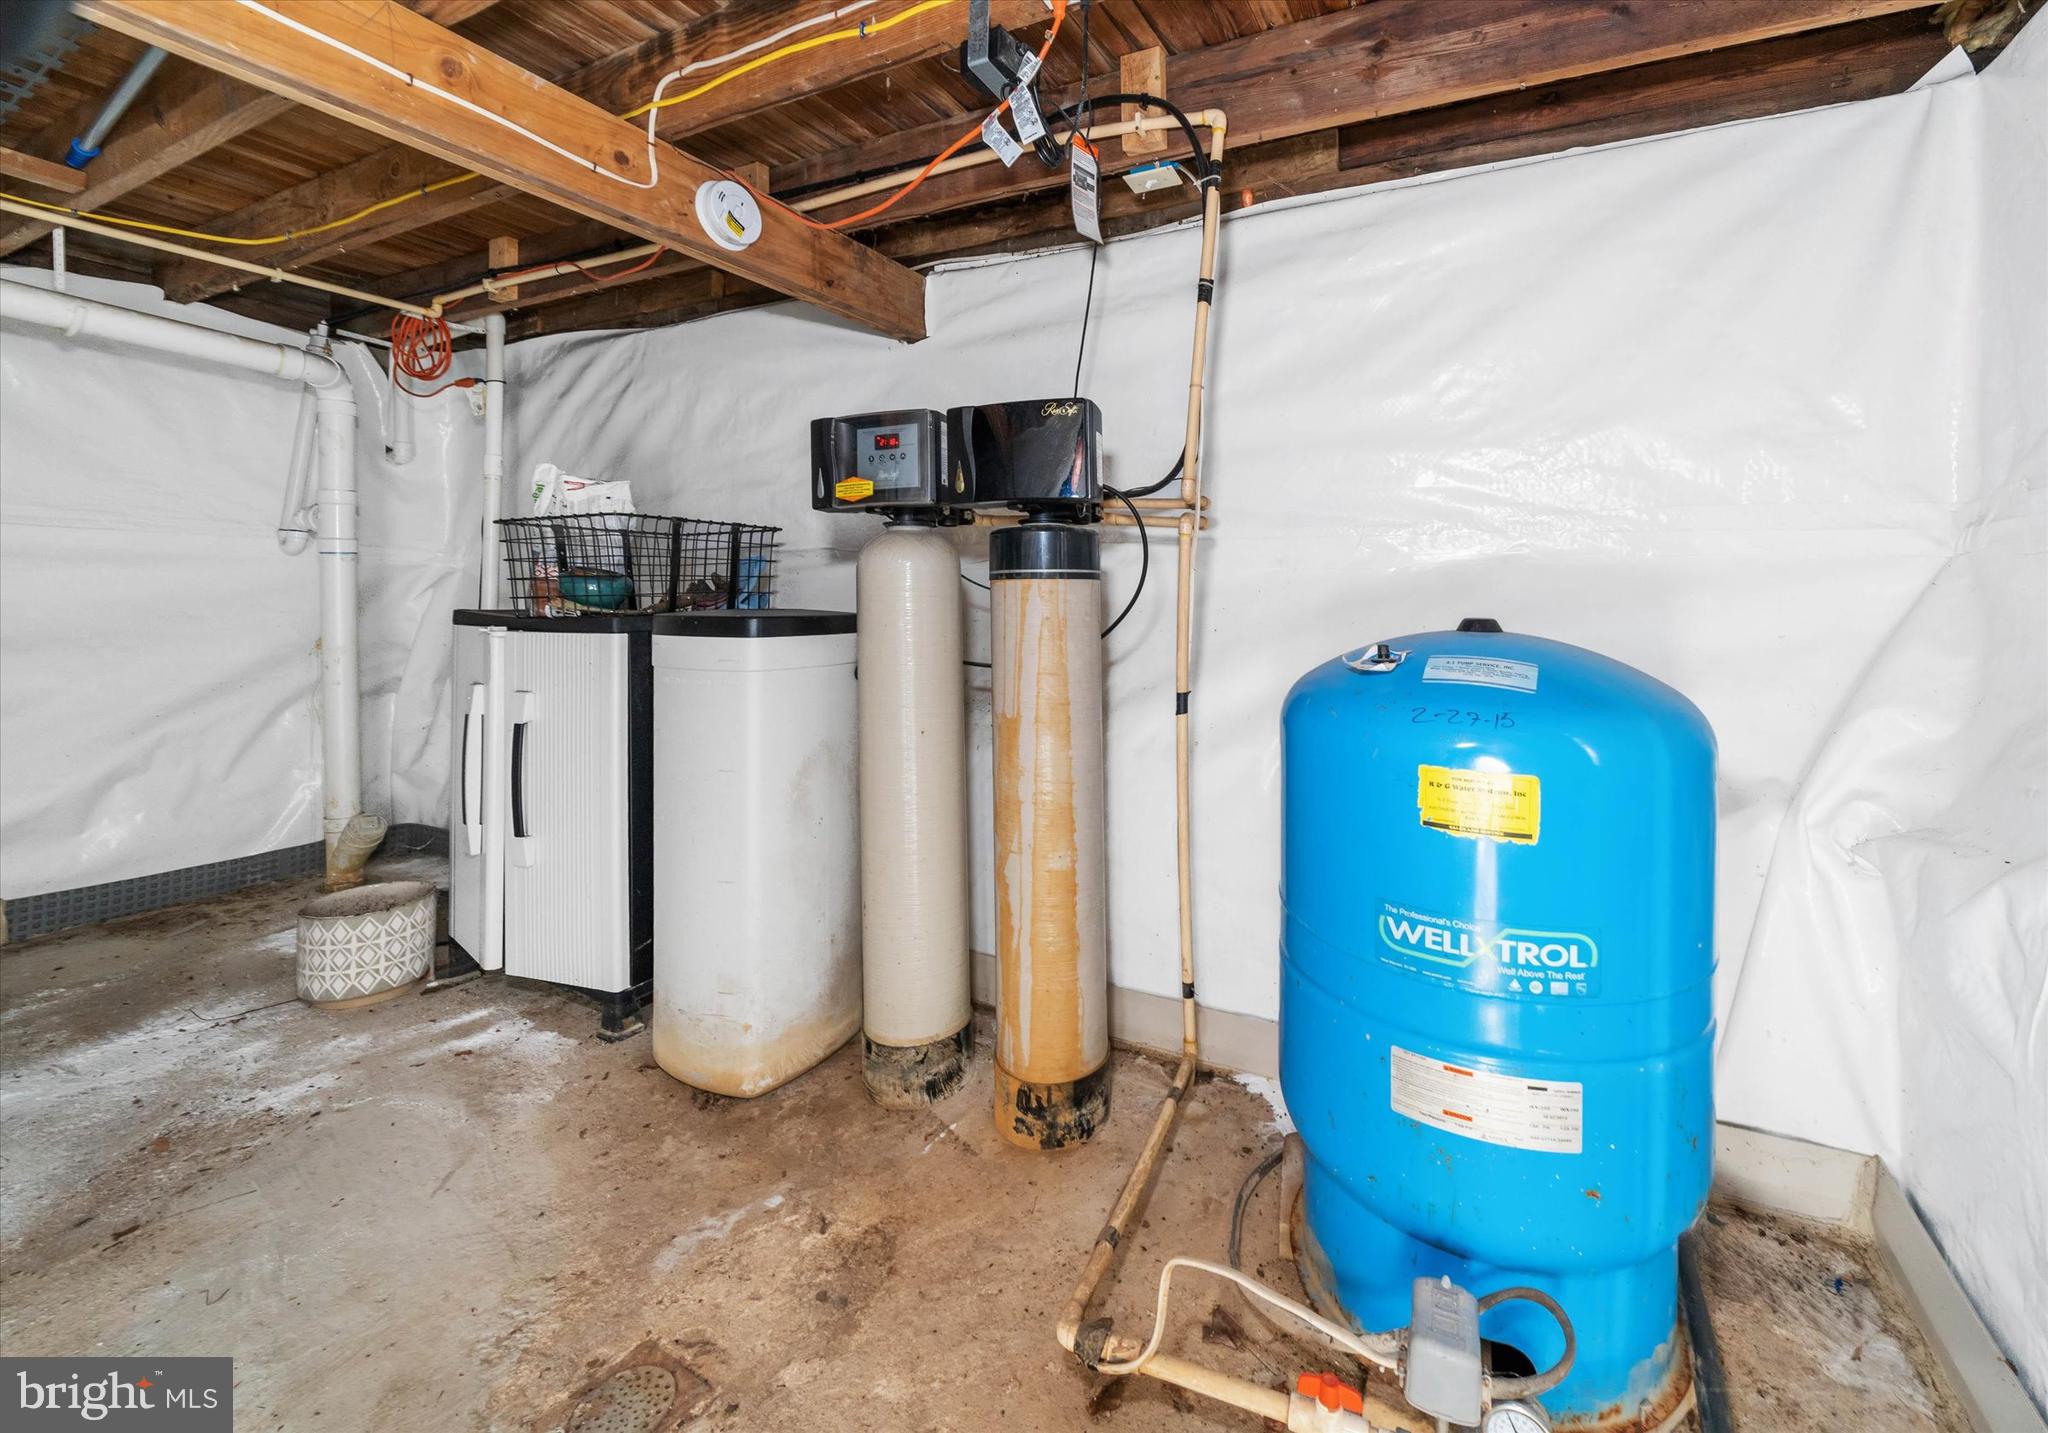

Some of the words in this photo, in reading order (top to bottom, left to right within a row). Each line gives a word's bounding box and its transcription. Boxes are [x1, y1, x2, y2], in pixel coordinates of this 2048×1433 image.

[531, 483, 546, 503] eal
[1384, 904, 1398, 915] The
[1399, 907, 1452, 927] Professional's
[1497, 966, 1517, 977] Well
[1517, 968, 1545, 979] Above
[1546, 970, 1563, 980] The
[1564, 971, 1586, 981] Rest
